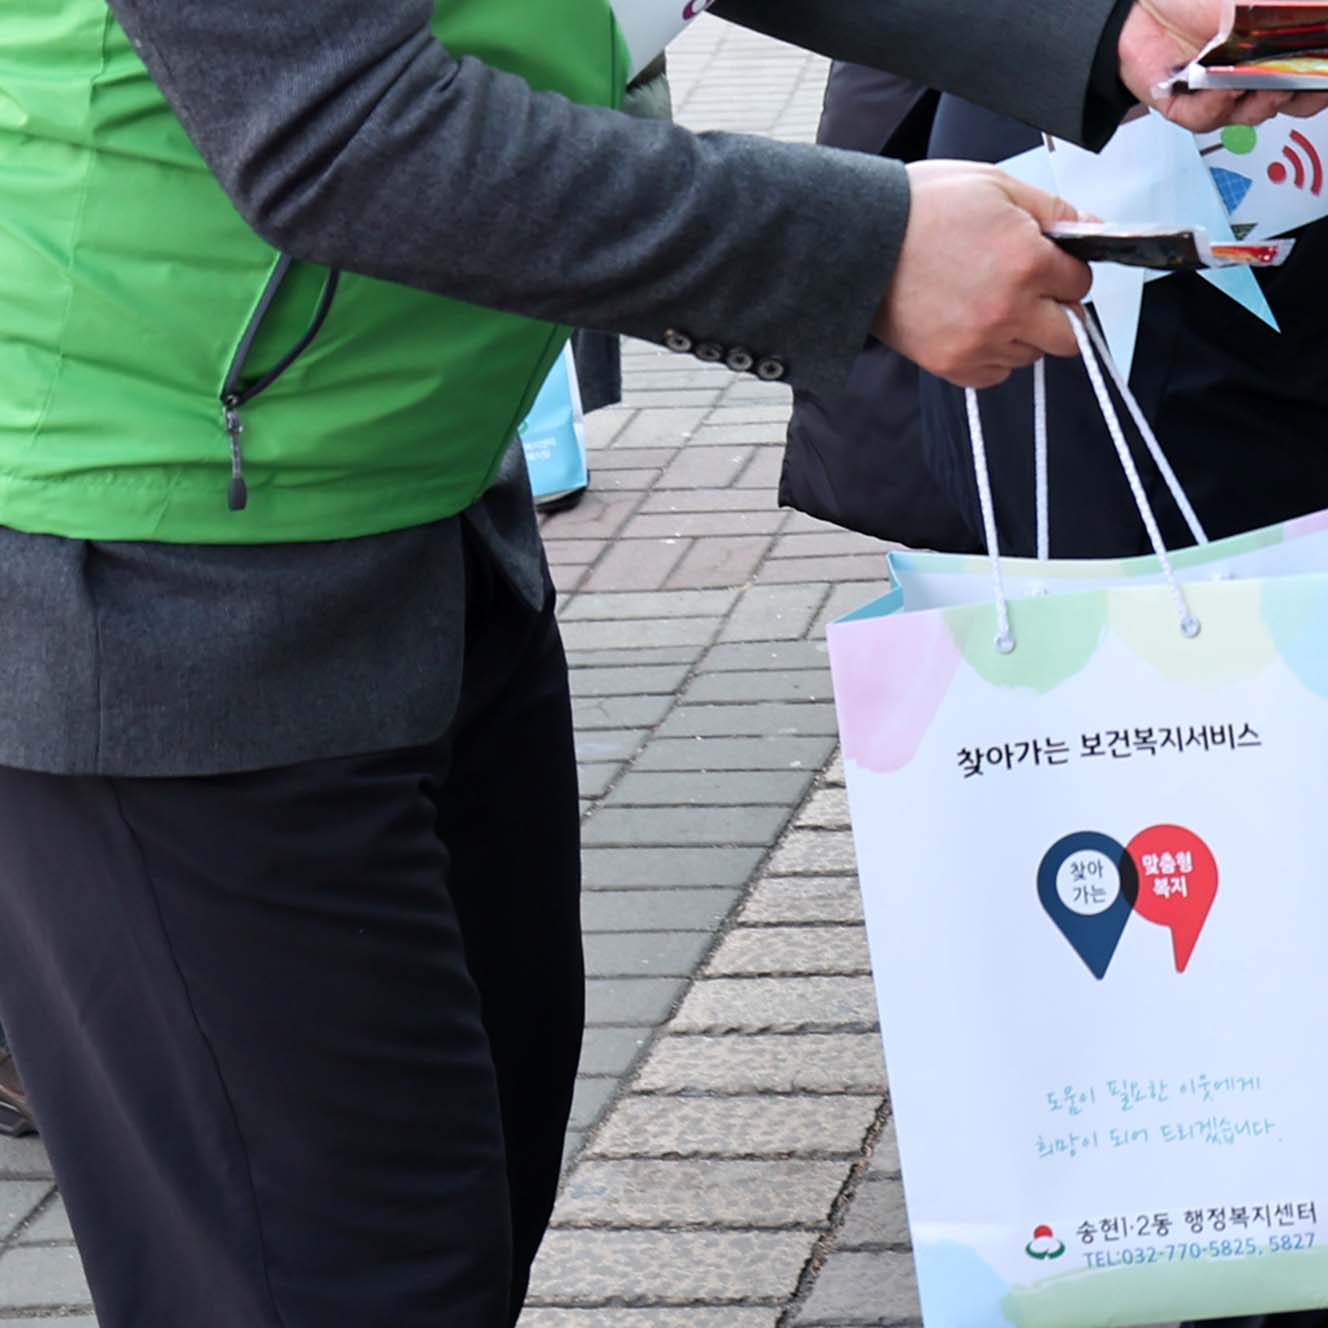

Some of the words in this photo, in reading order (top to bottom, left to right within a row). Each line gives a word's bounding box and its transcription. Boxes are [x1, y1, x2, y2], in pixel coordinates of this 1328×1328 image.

[956, 736, 1070, 779] 찾아가는
[1080, 722, 1262, 759] 보건복지서비스
[1070, 859, 1104, 882] 찾아
[1141, 851, 1193, 876] 맞춤형
[1072, 884, 1107, 905] 가는
[1153, 876, 1188, 899] 복지
[1047, 1085, 1096, 1115] 도움이
[1106, 1079, 1169, 1111] 필요한
[1179, 1073, 1262, 1102] 이웃에게
[1034, 1131, 1098, 1158] 희망이
[1109, 1128, 1149, 1148] 되어
[1183, 1201, 1318, 1234] 행정복지센터
[1268, 1231, 1316, 1254] 5827
